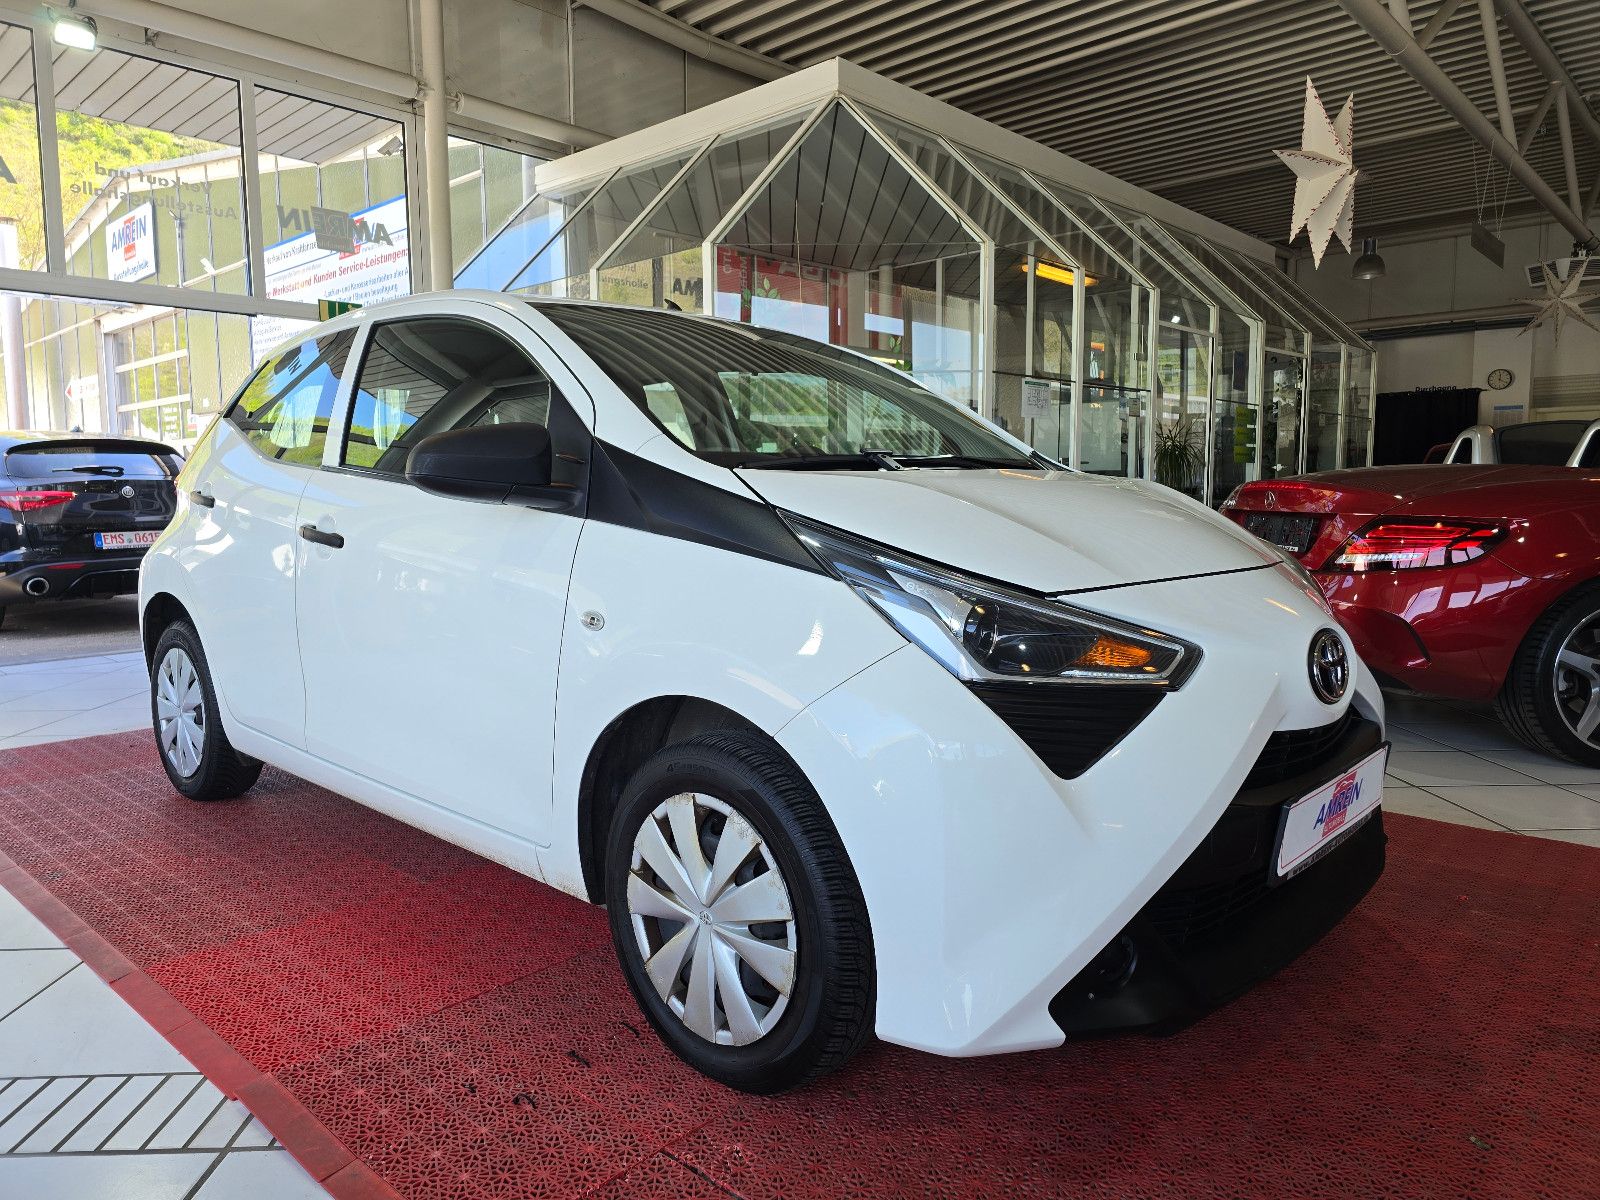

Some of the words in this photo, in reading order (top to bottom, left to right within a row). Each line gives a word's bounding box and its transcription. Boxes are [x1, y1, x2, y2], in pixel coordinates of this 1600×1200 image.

[112, 215, 147, 253] AMREIN
[313, 270, 337, 285] Kunden
[103, 533, 125, 545] EMS
[1313, 778, 1364, 830] AMREIN
